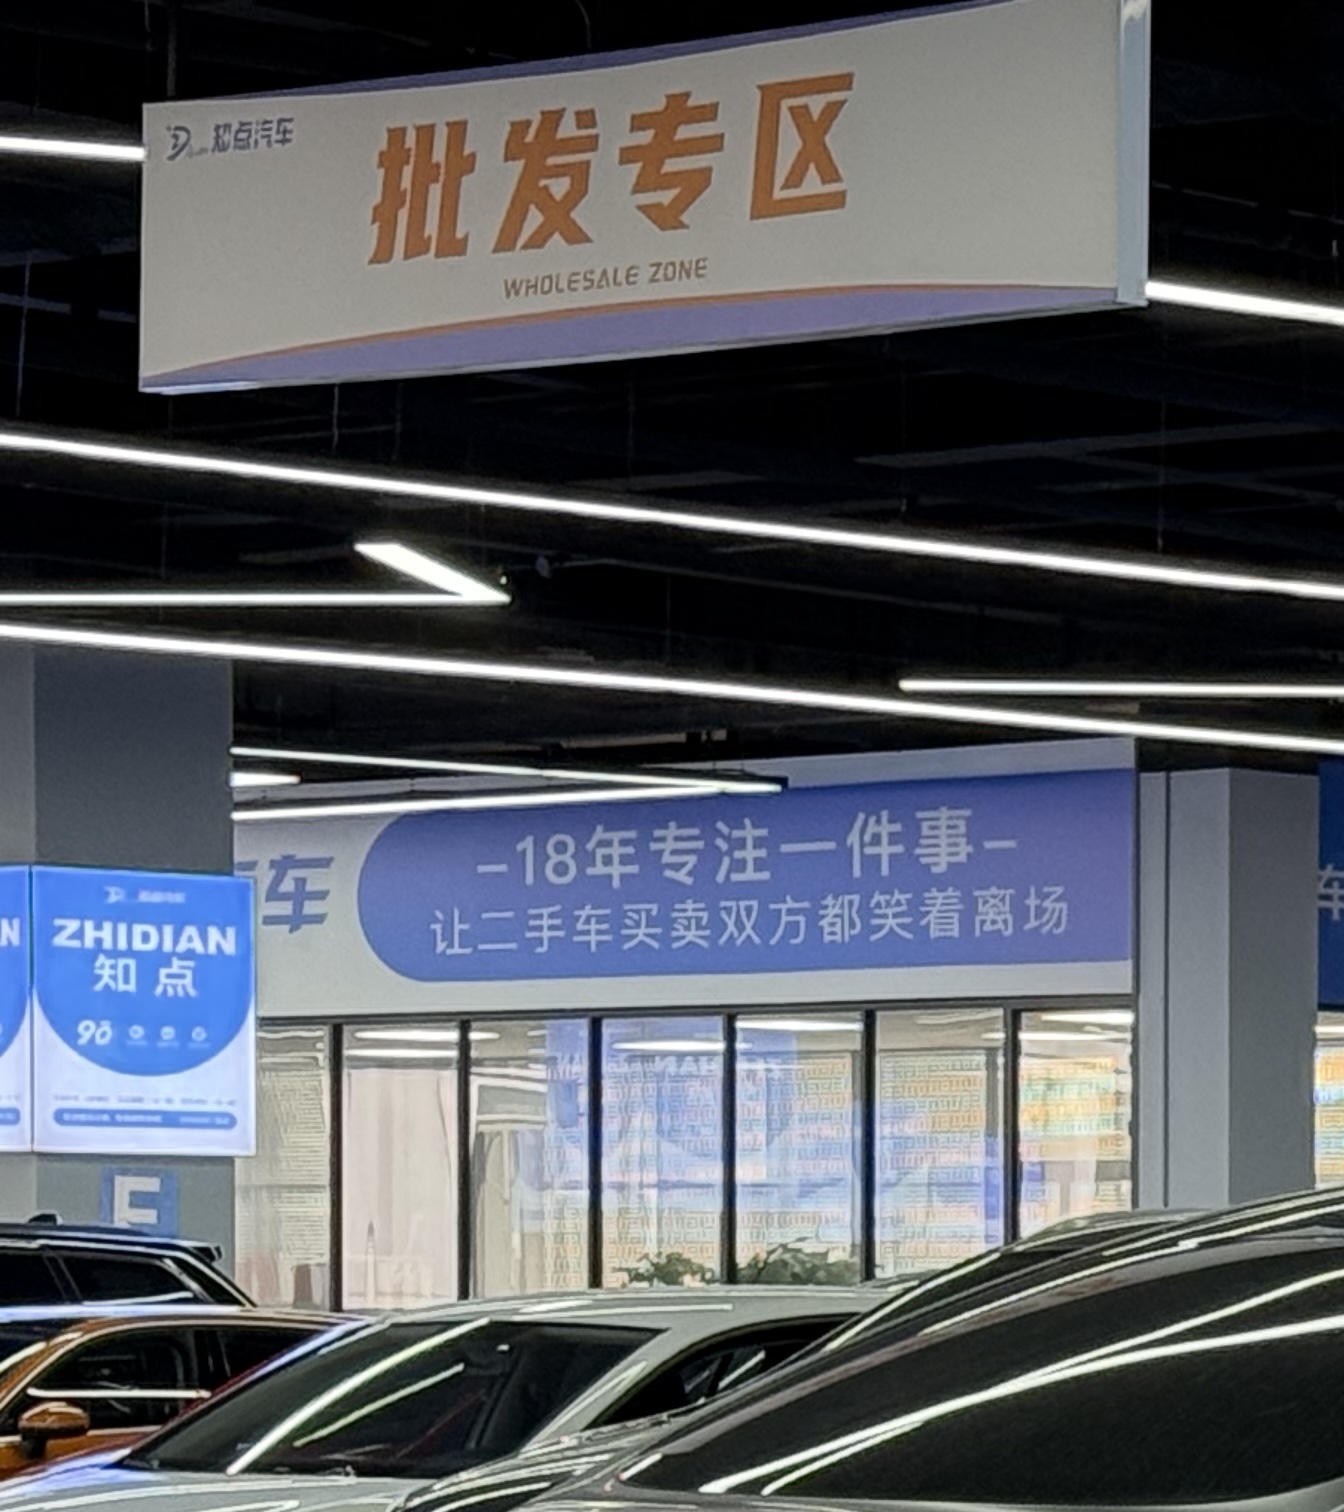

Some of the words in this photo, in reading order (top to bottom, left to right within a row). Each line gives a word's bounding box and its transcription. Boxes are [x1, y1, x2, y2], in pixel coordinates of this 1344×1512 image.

[368, 71, 855, 266] 批发专区
[503, 264, 641, 300] WHOLESALE
[647, 257, 709, 284] ZONE
[235, 853, 334, 934] 车
[430, 884, 1072, 956] 让二手车买卖双方都笑着离场
[52, 918, 236, 956] ZHIDIAN
[93, 953, 198, 997] 知点
